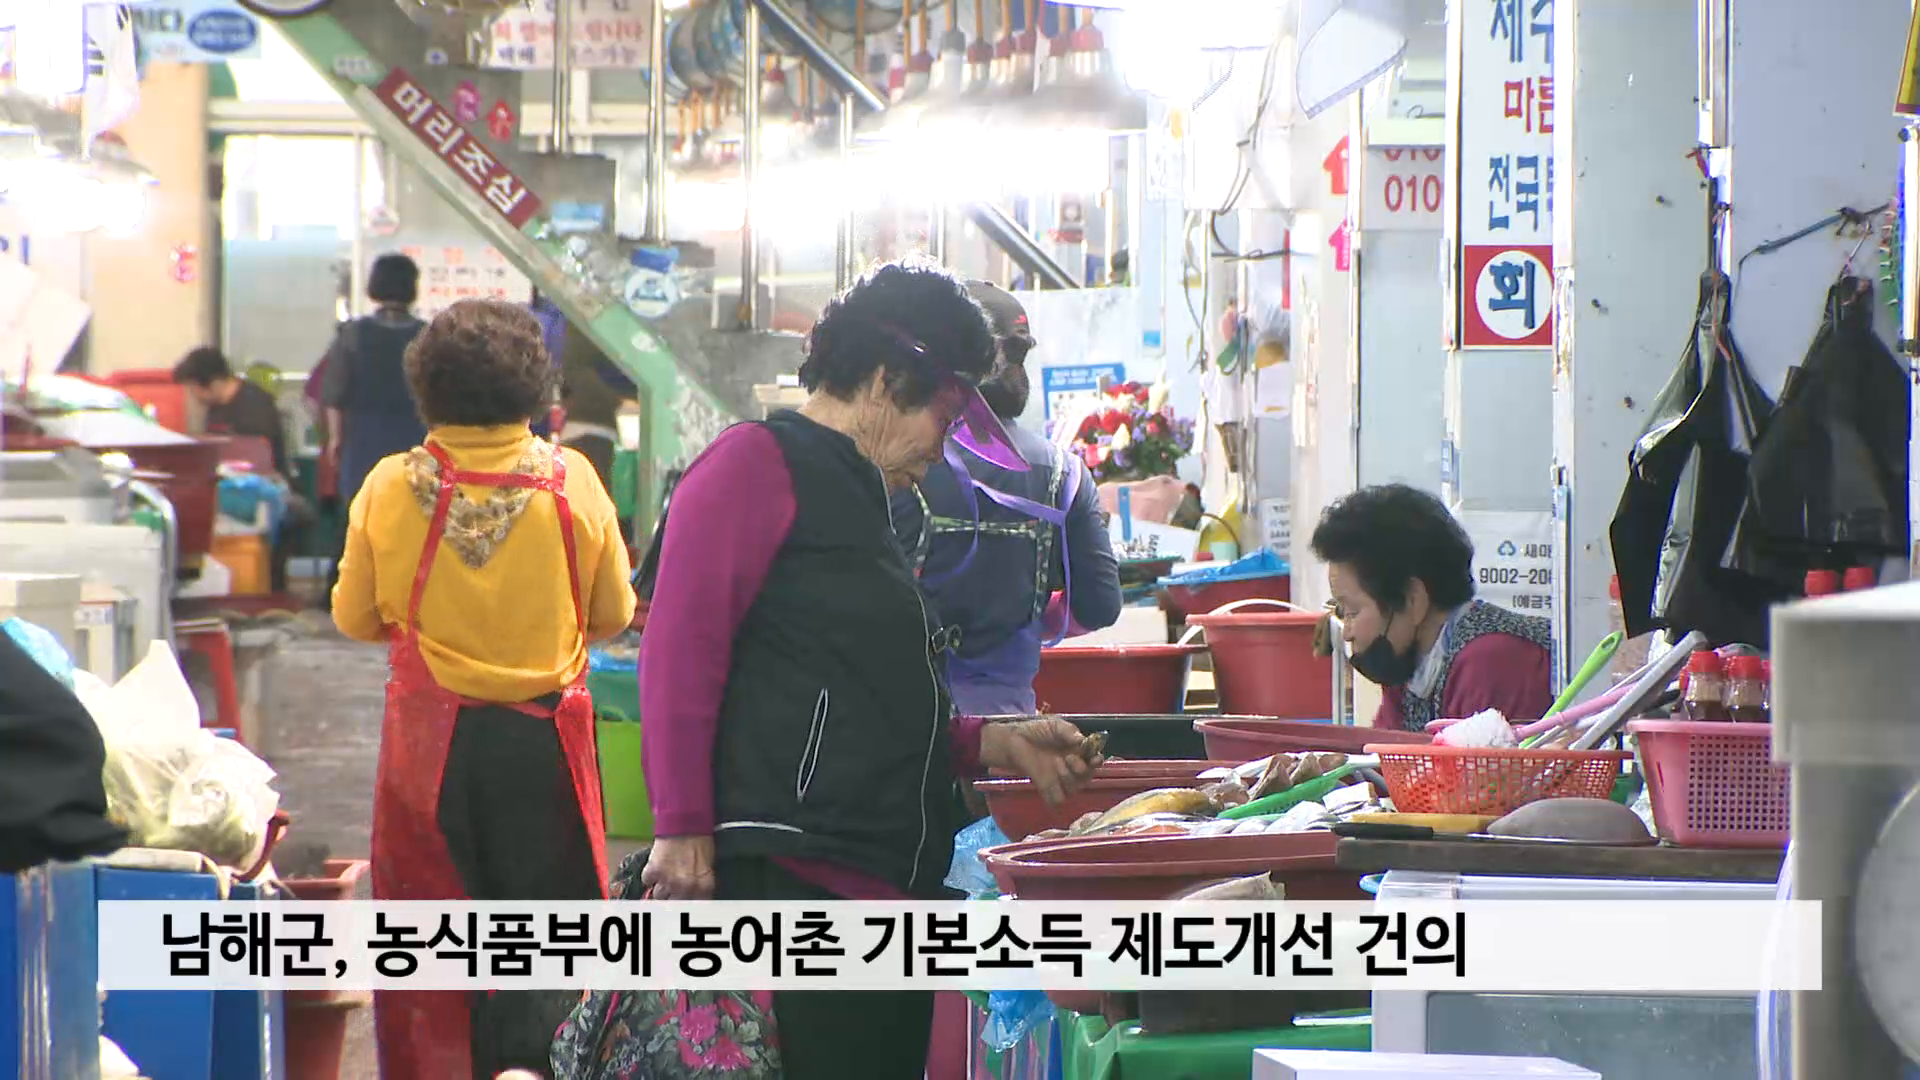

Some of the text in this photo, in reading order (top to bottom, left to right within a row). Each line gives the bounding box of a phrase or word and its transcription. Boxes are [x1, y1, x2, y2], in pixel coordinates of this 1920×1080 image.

[392, 81, 527, 214] 머리조심
[1384, 174, 1441, 213] 010
[1488, 154, 1553, 231] 전국
[1488, 260, 1536, 329] 회
